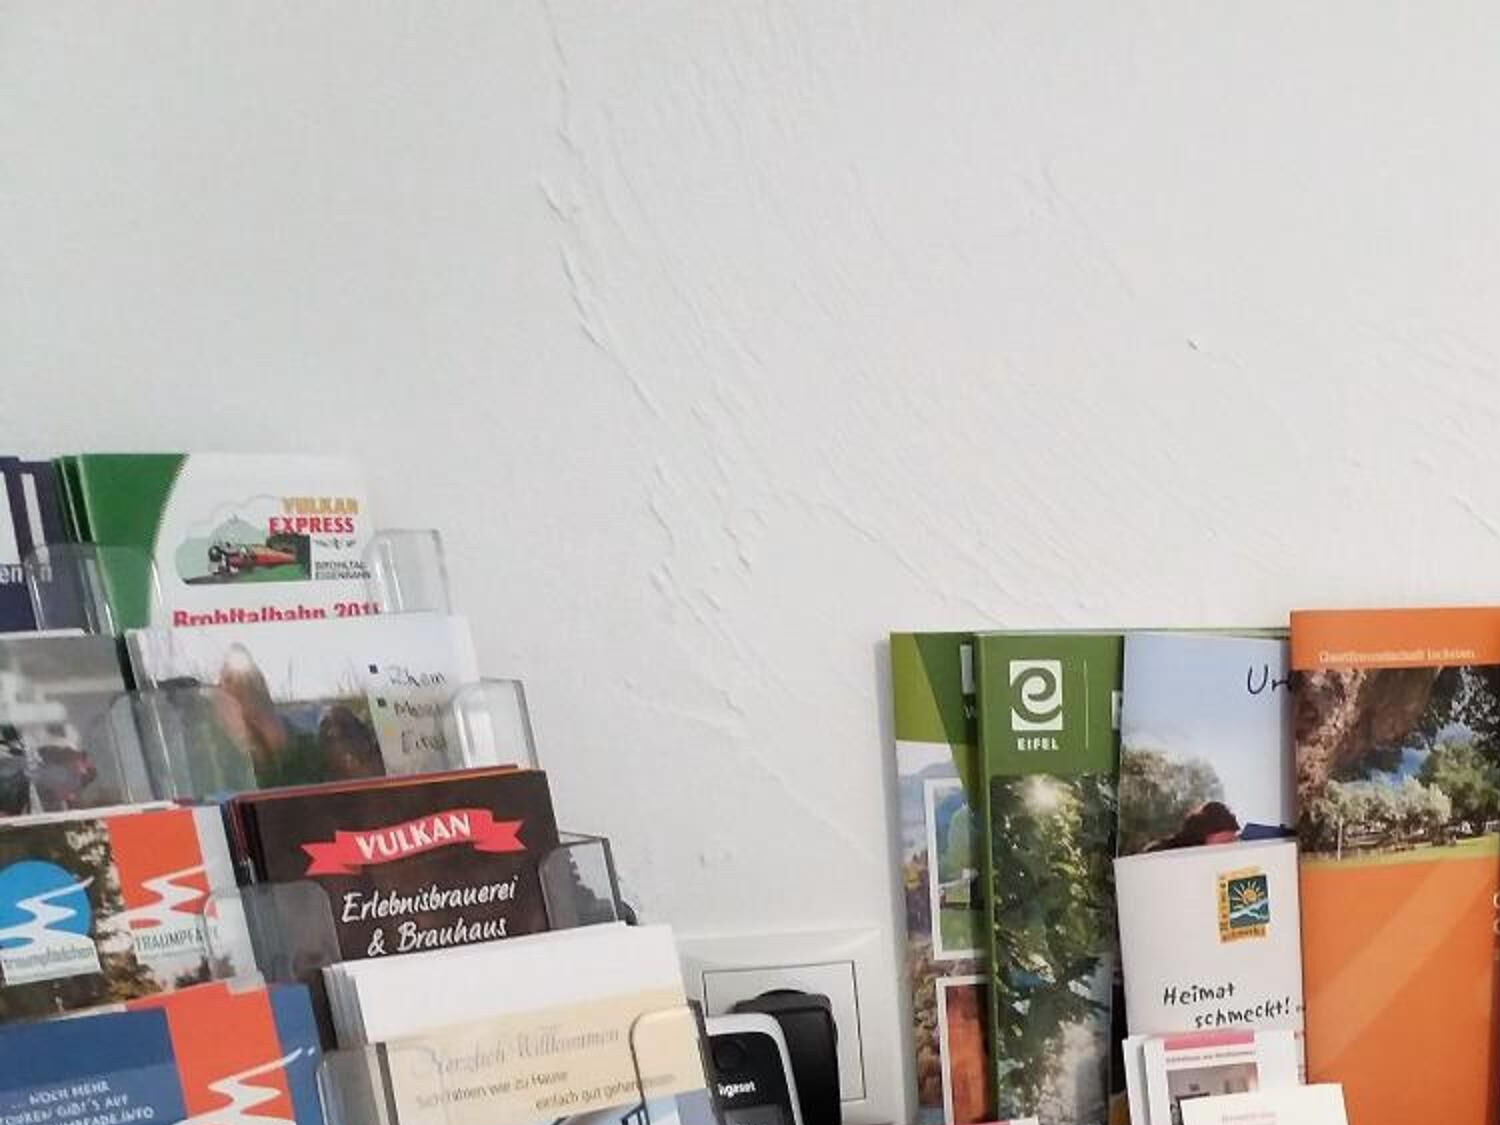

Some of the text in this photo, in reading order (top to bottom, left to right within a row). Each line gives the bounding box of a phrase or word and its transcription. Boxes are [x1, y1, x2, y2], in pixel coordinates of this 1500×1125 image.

[268, 516, 354, 534] EXPRESS
[1017, 737, 1060, 751] EIFEL
[354, 811, 472, 860] VULKAN
[341, 874, 519, 923] Erlebnisbrauerei
[367, 916, 507, 957] & Brauhaus
[1163, 981, 1235, 1006] Heimat
[1194, 997, 1291, 1028] schmeckt!
